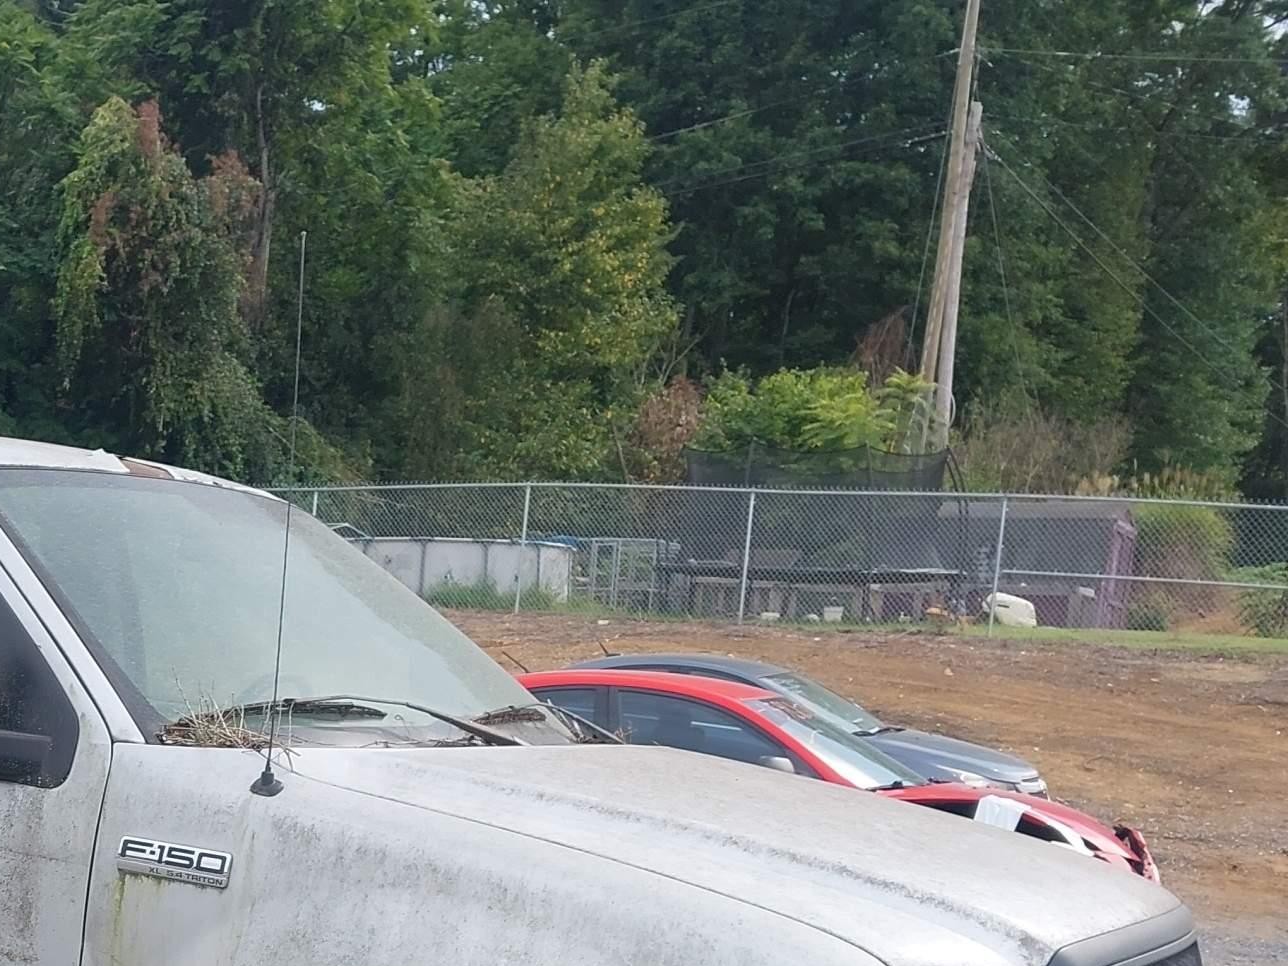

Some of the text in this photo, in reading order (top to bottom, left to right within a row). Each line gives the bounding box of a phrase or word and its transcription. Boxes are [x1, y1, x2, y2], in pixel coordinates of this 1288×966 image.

[120, 839, 227, 874] F-150
[149, 866, 162, 875] XL
[185, 873, 224, 886] TRITON
